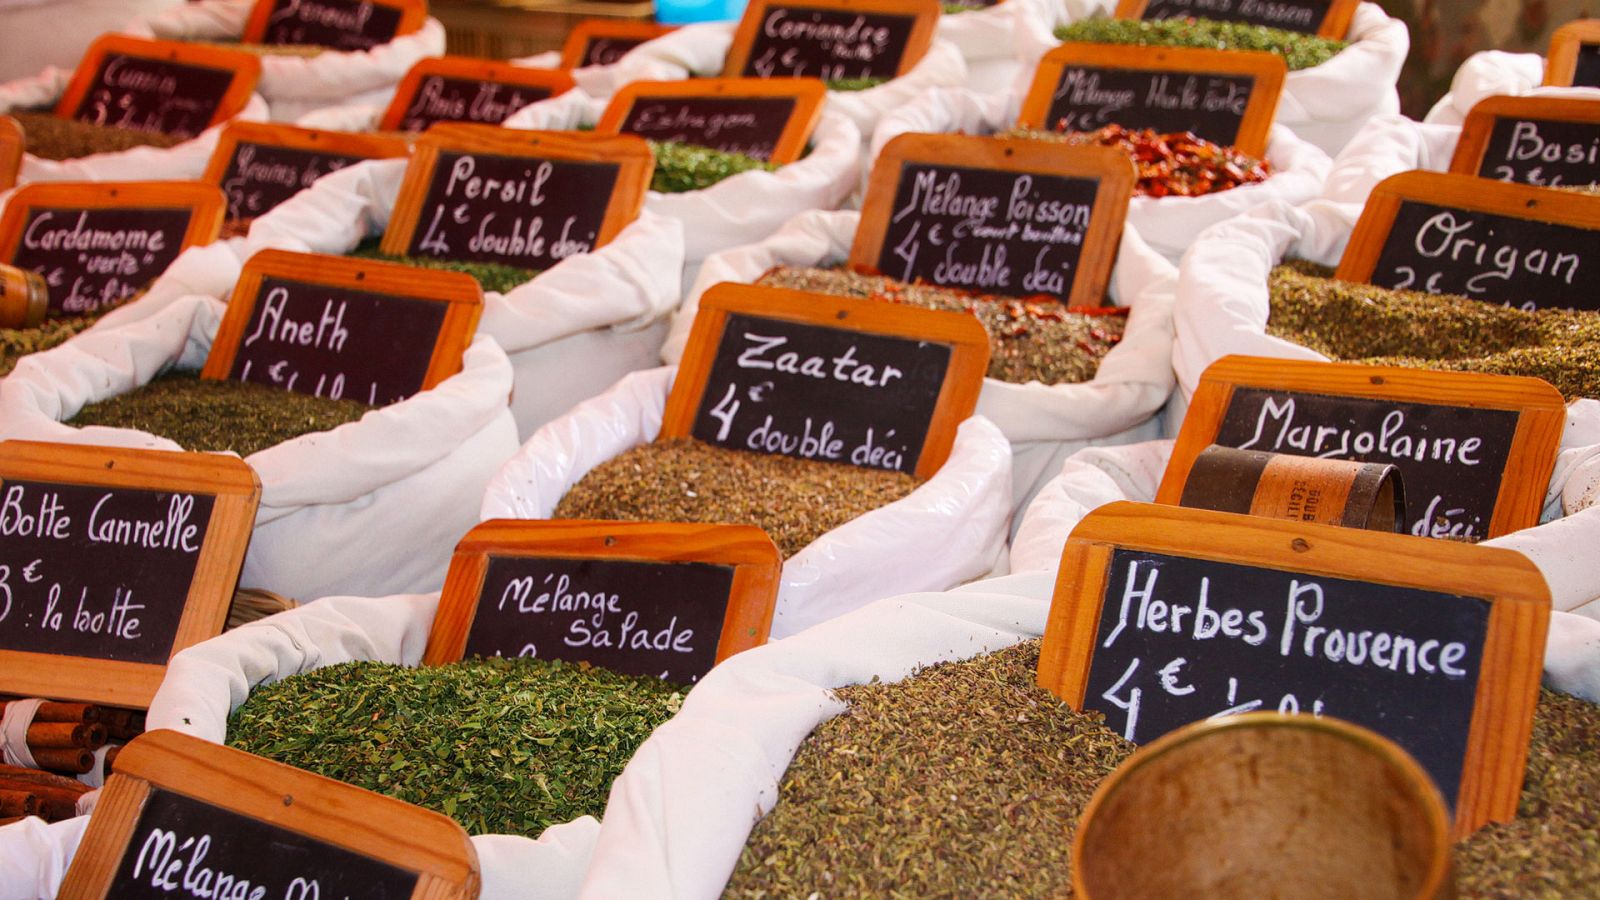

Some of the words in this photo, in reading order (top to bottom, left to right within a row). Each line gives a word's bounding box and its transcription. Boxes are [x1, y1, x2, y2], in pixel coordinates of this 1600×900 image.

[445, 155, 553, 207] Persil
[892, 169, 999, 239] Mélange
[1005, 174, 1091, 229] Poisson
[24, 200, 166, 251] Cardamome
[468, 211, 546, 257] double
[1414, 210, 1581, 294] Origan
[933, 241, 1011, 288] double
[244, 286, 349, 354] Aneth
[736, 331, 903, 388] Zaatar
[746, 414, 845, 460] double
[850, 427, 908, 470] déci
[1237, 396, 1482, 466] Marjolaine
[0, 485, 72, 540] Botte
[87, 493, 199, 553] Cannelle
[1411, 494, 1482, 539] déci
[72, 585, 147, 640] botte
[498, 573, 623, 629] Mélange
[1102, 560, 1270, 649] Herbes
[1279, 579, 1467, 680] Provence
[563, 610, 695, 653] Salade
